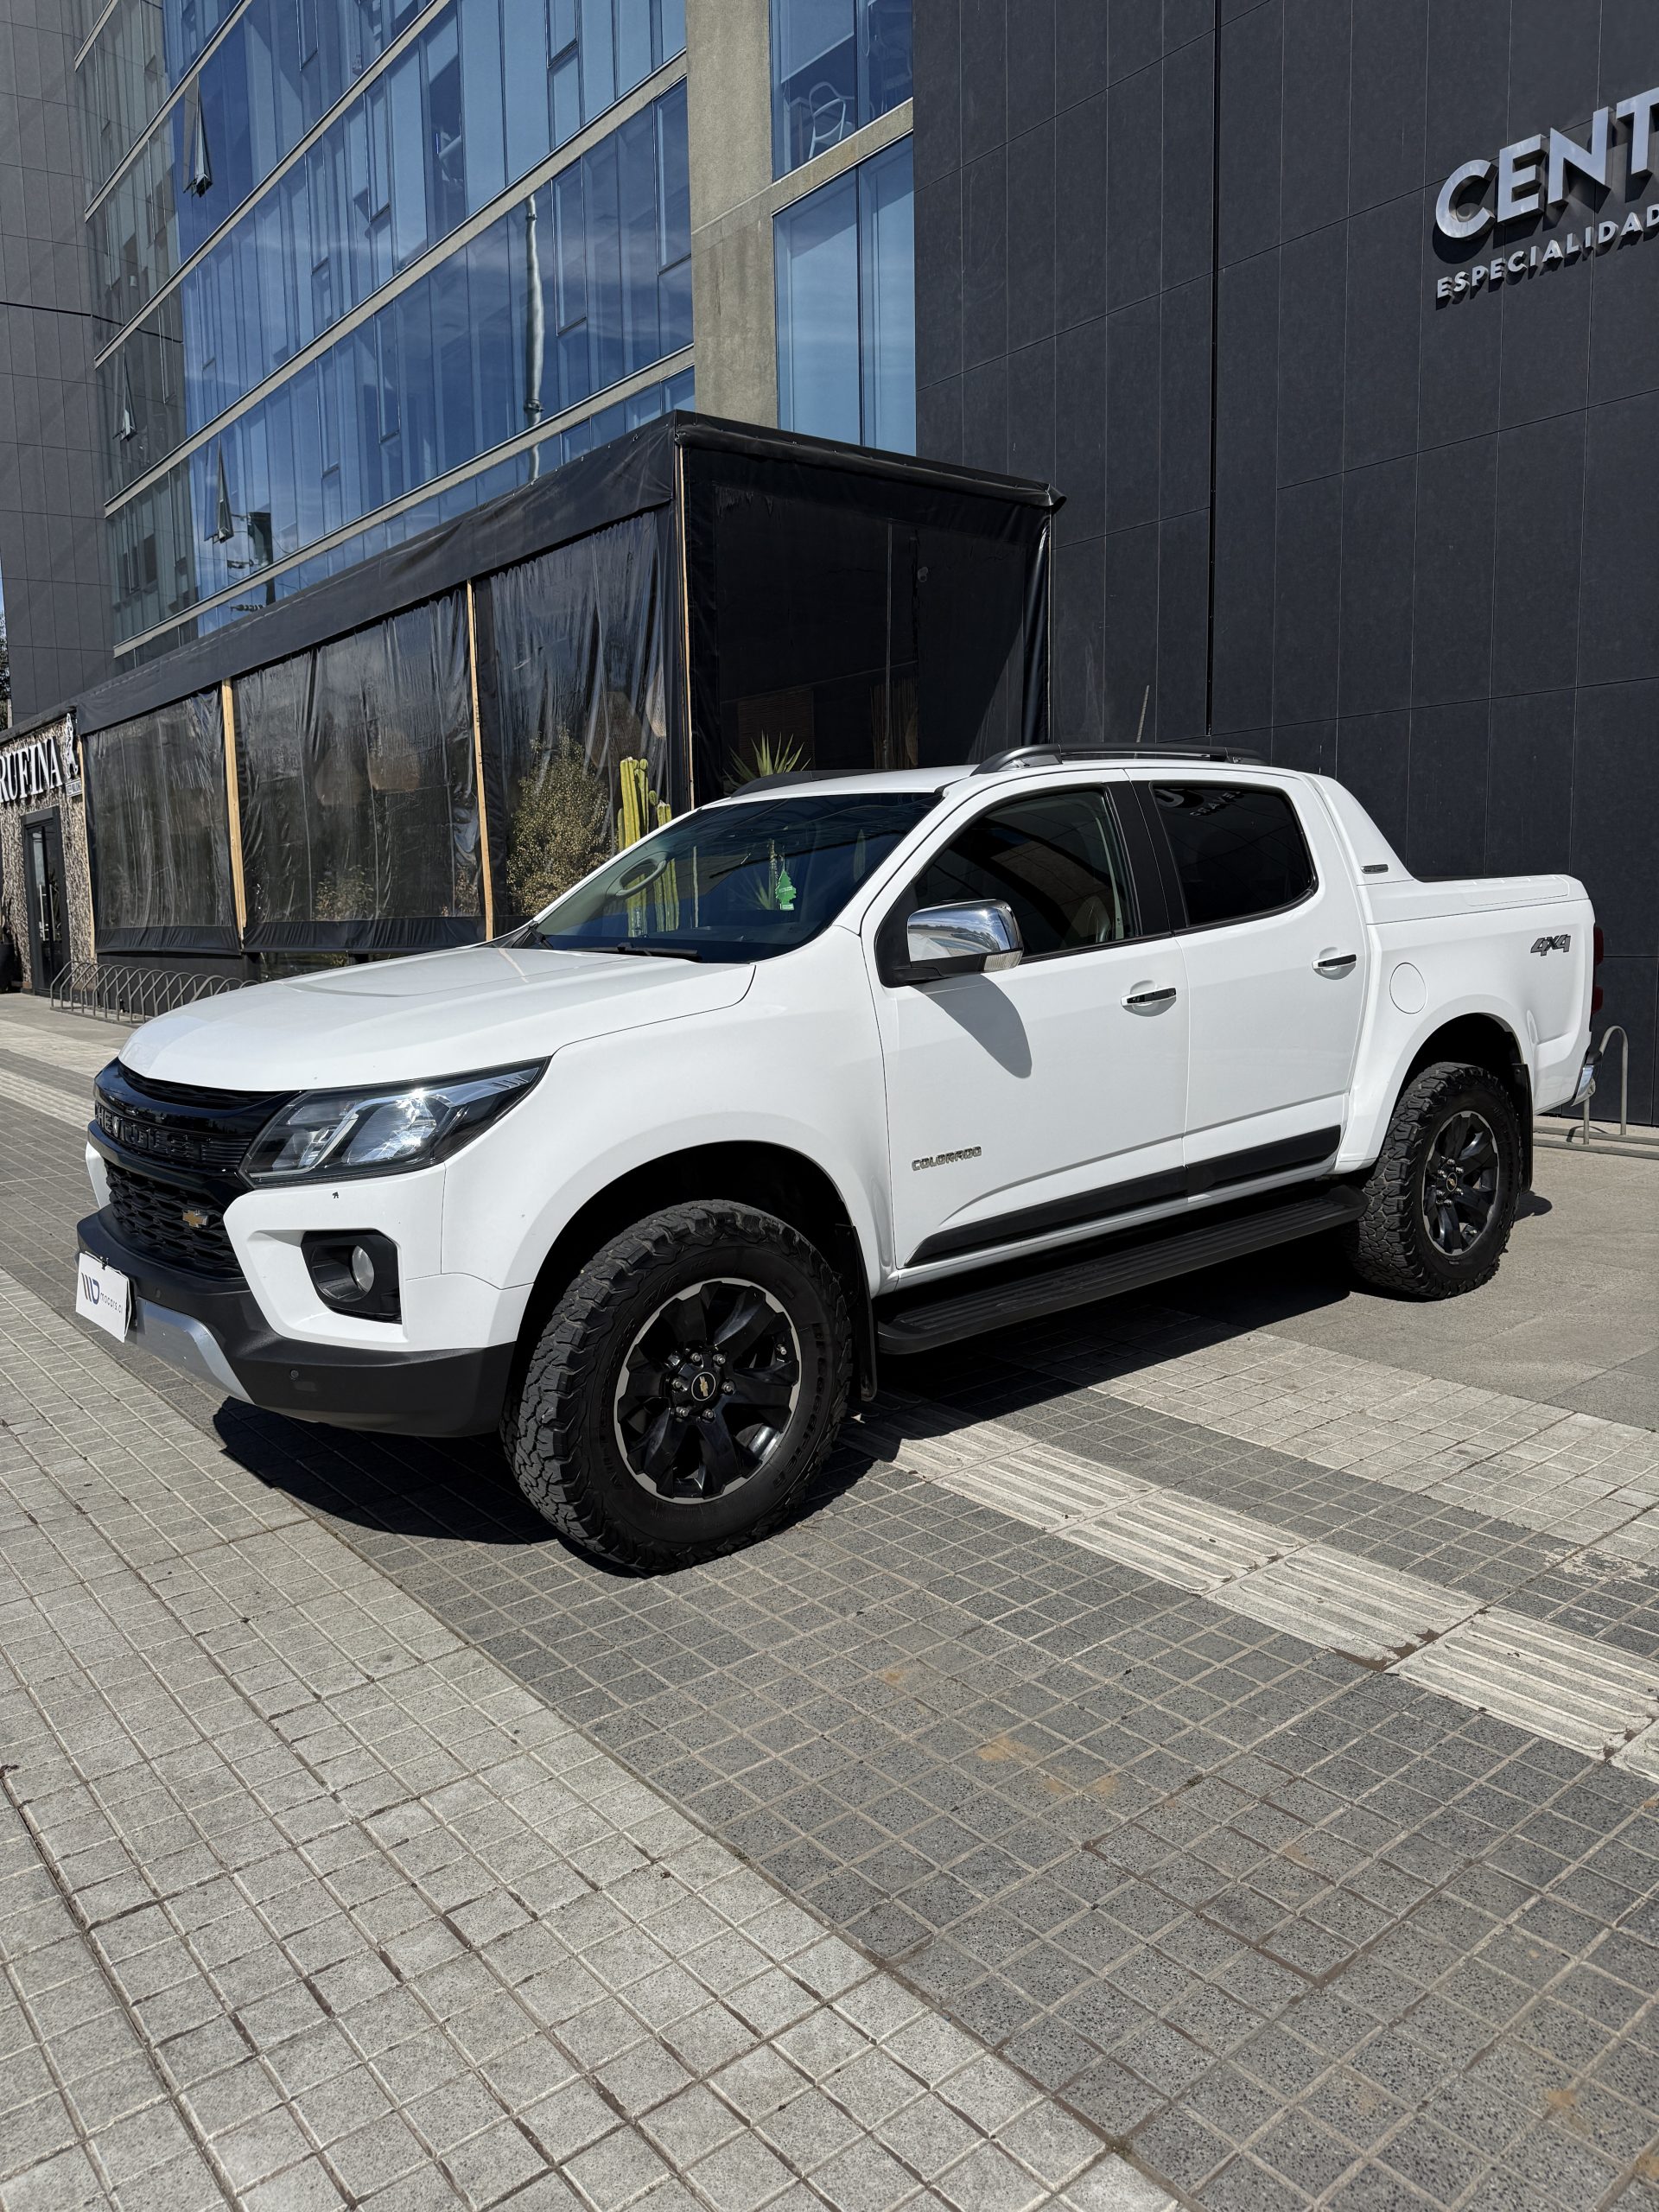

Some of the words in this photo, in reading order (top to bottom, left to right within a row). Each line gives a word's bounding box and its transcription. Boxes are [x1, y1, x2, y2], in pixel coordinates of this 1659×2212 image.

[1435, 87, 1659, 238] CENT
[1437, 204, 1659, 299] ESPECIALIDAD
[912, 1146, 982, 1172] COLORADO
